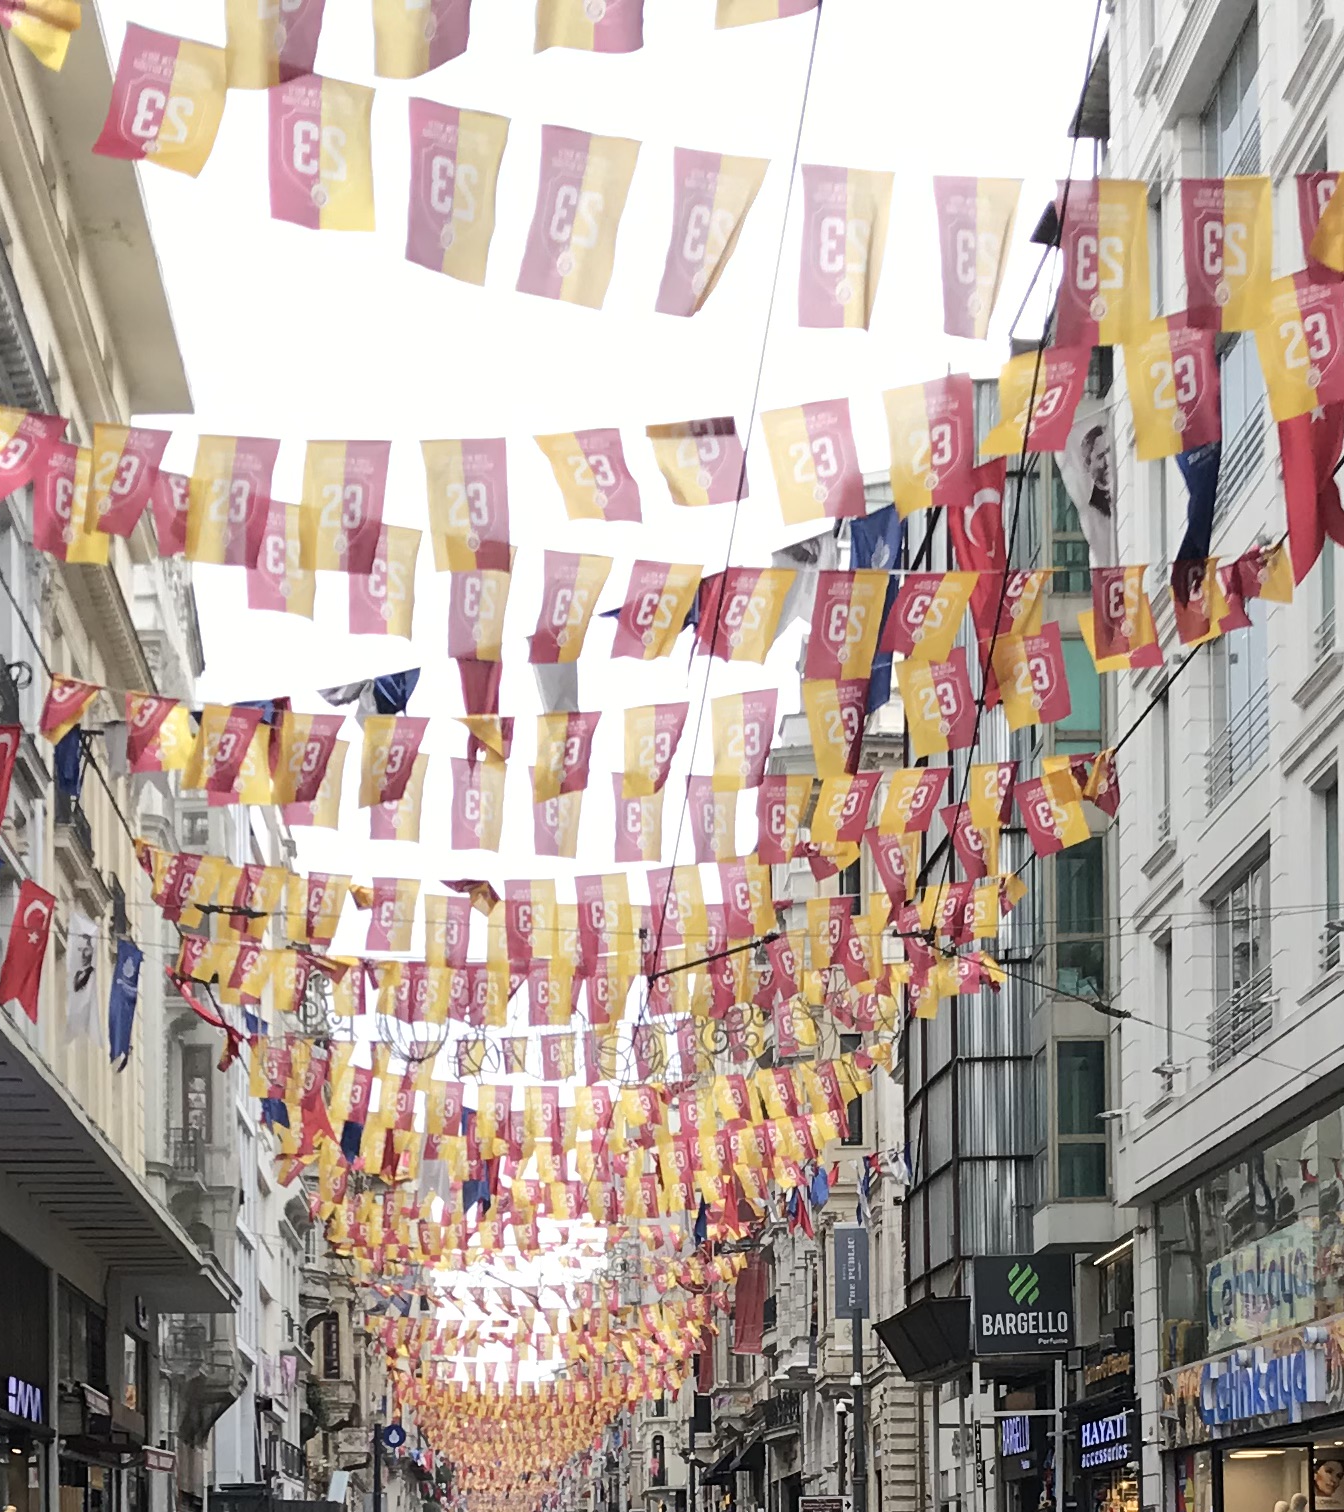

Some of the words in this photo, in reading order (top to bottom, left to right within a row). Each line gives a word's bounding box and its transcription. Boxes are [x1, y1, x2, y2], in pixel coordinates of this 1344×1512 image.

[1279, 310, 1331, 369] 23
[1150, 353, 1198, 410] 23
[789, 436, 838, 483] 23
[908, 423, 951, 475] 23
[95, 452, 140, 496] 23
[569, 454, 615, 487] 23
[208, 479, 250, 524] 23
[321, 486, 364, 529] 23
[446, 482, 487, 527] 23
[1015, 659, 1053, 696] 23
[921, 675, 956, 720] 23
[728, 723, 759, 757] 23
[828, 707, 858, 743] 23
[291, 741, 321, 774] 23
[373, 745, 405, 779] 23
[550, 734, 579, 771] 23
[640, 731, 671, 765] 23
[986, 768, 1012, 800] 23
[848, 1237, 856, 1281] PUBLIC
[982, 1310, 1069, 1336] BARGELLO
[1037, 1337, 1069, 1345] Perfume
[1081, 1443, 1128, 1469] accessories
